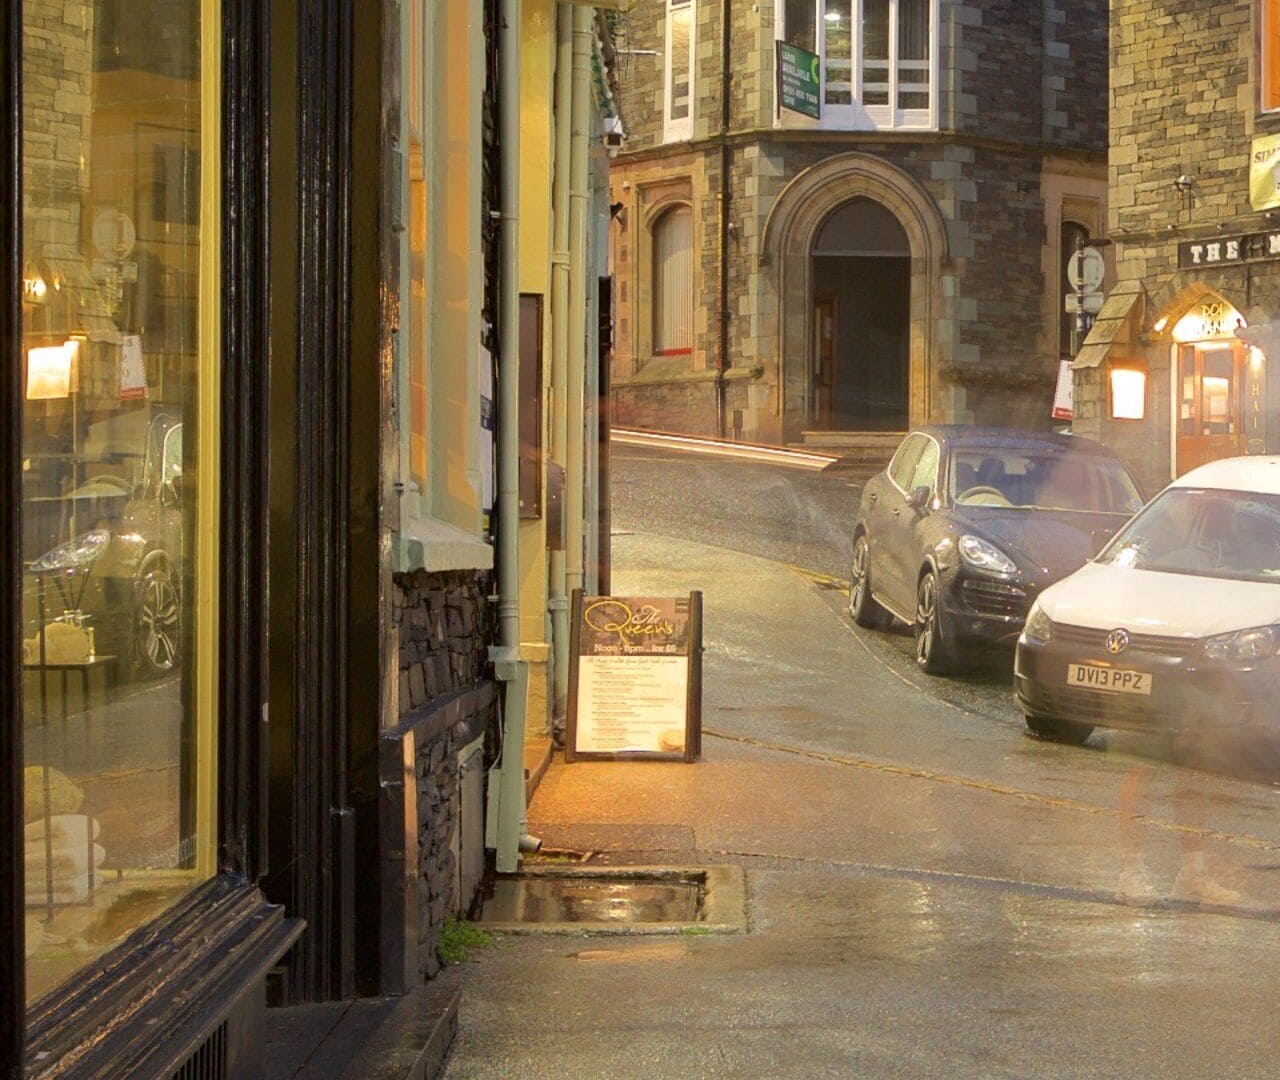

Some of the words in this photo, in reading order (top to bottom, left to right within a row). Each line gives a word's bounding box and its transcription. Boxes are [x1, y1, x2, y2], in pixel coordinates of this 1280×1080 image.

[1191, 240, 1239, 263] THE
[632, 605, 661, 625] The
[1076, 667, 1108, 685] DV13
[1112, 672, 1143, 689] PPZ
